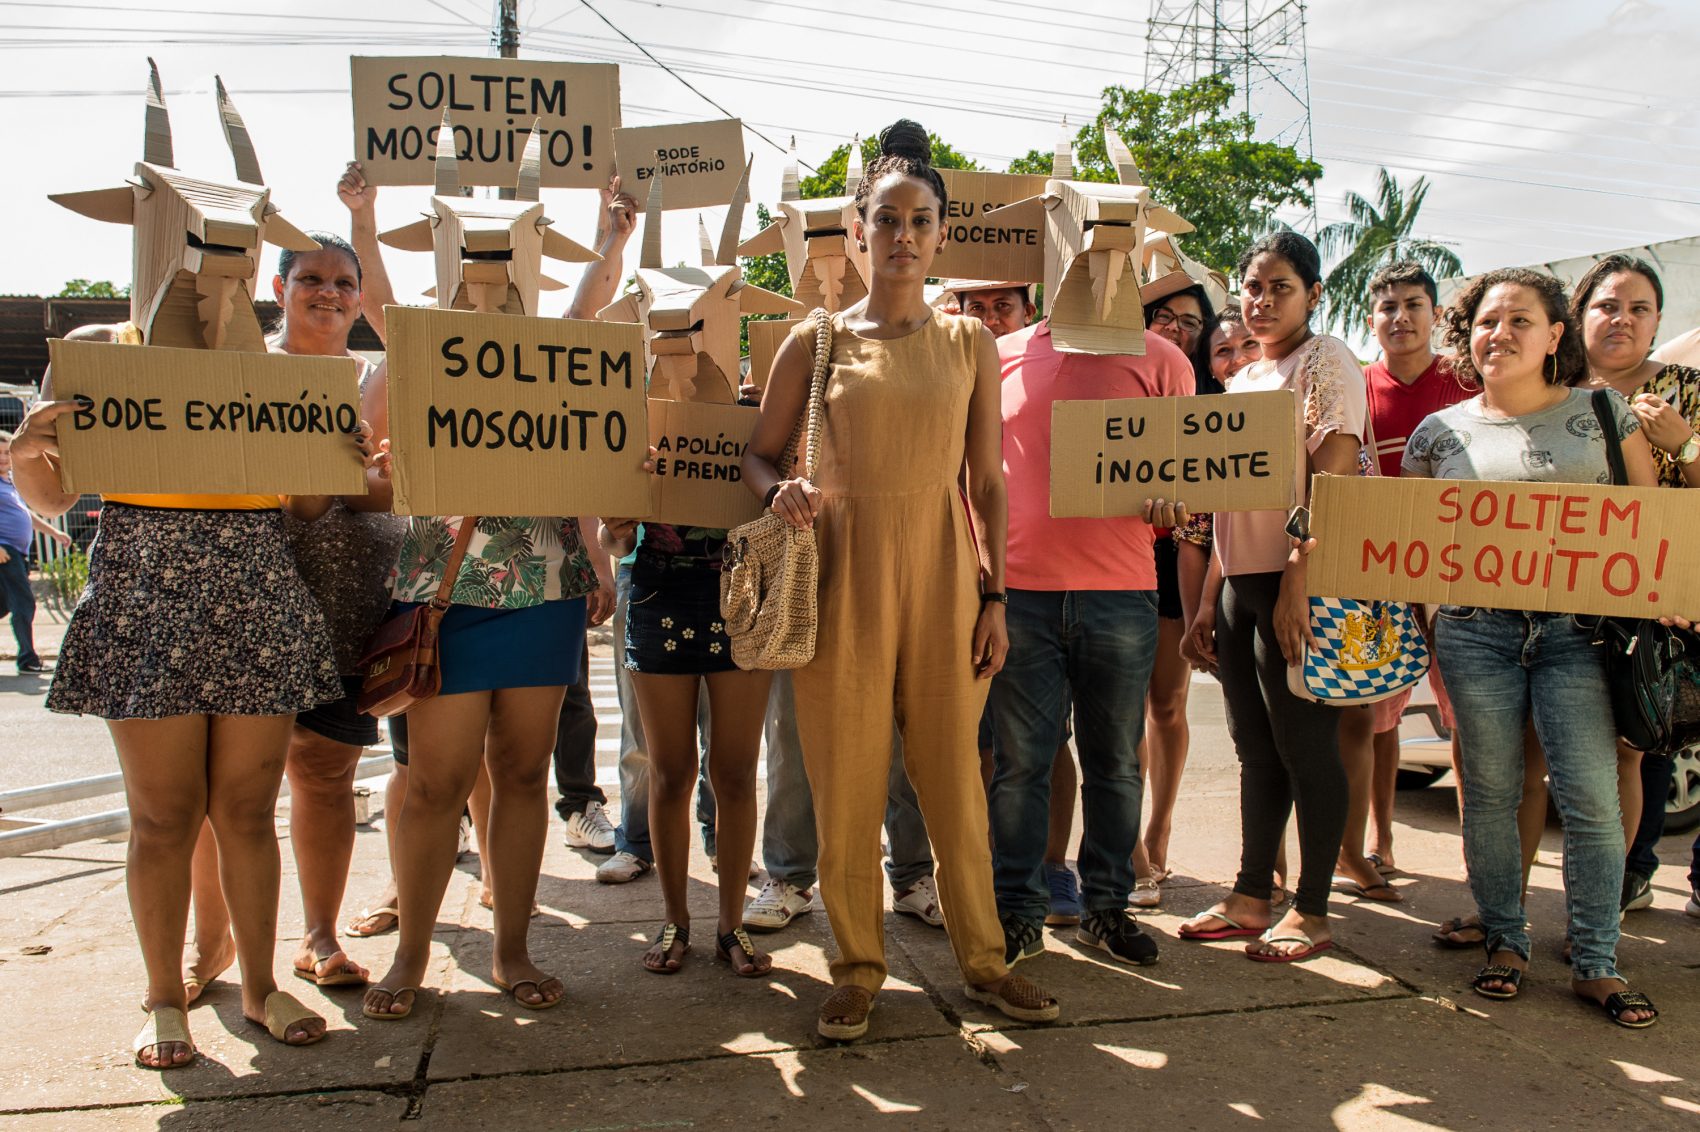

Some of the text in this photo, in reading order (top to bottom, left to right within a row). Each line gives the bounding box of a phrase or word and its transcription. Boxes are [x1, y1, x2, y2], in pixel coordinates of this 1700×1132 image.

[388, 72, 567, 117] SOLTEM
[657, 146, 701, 162] BODE
[947, 201, 975, 218] EU
[947, 225, 1039, 246] OCENTE
[441, 336, 632, 390] SOLTEM
[73, 393, 167, 431] BODE
[1106, 411, 1246, 441] EU SOU
[656, 435, 672, 452] A
[650, 457, 742, 482] E PREND
[1437, 486, 1642, 540] SOLTEM
